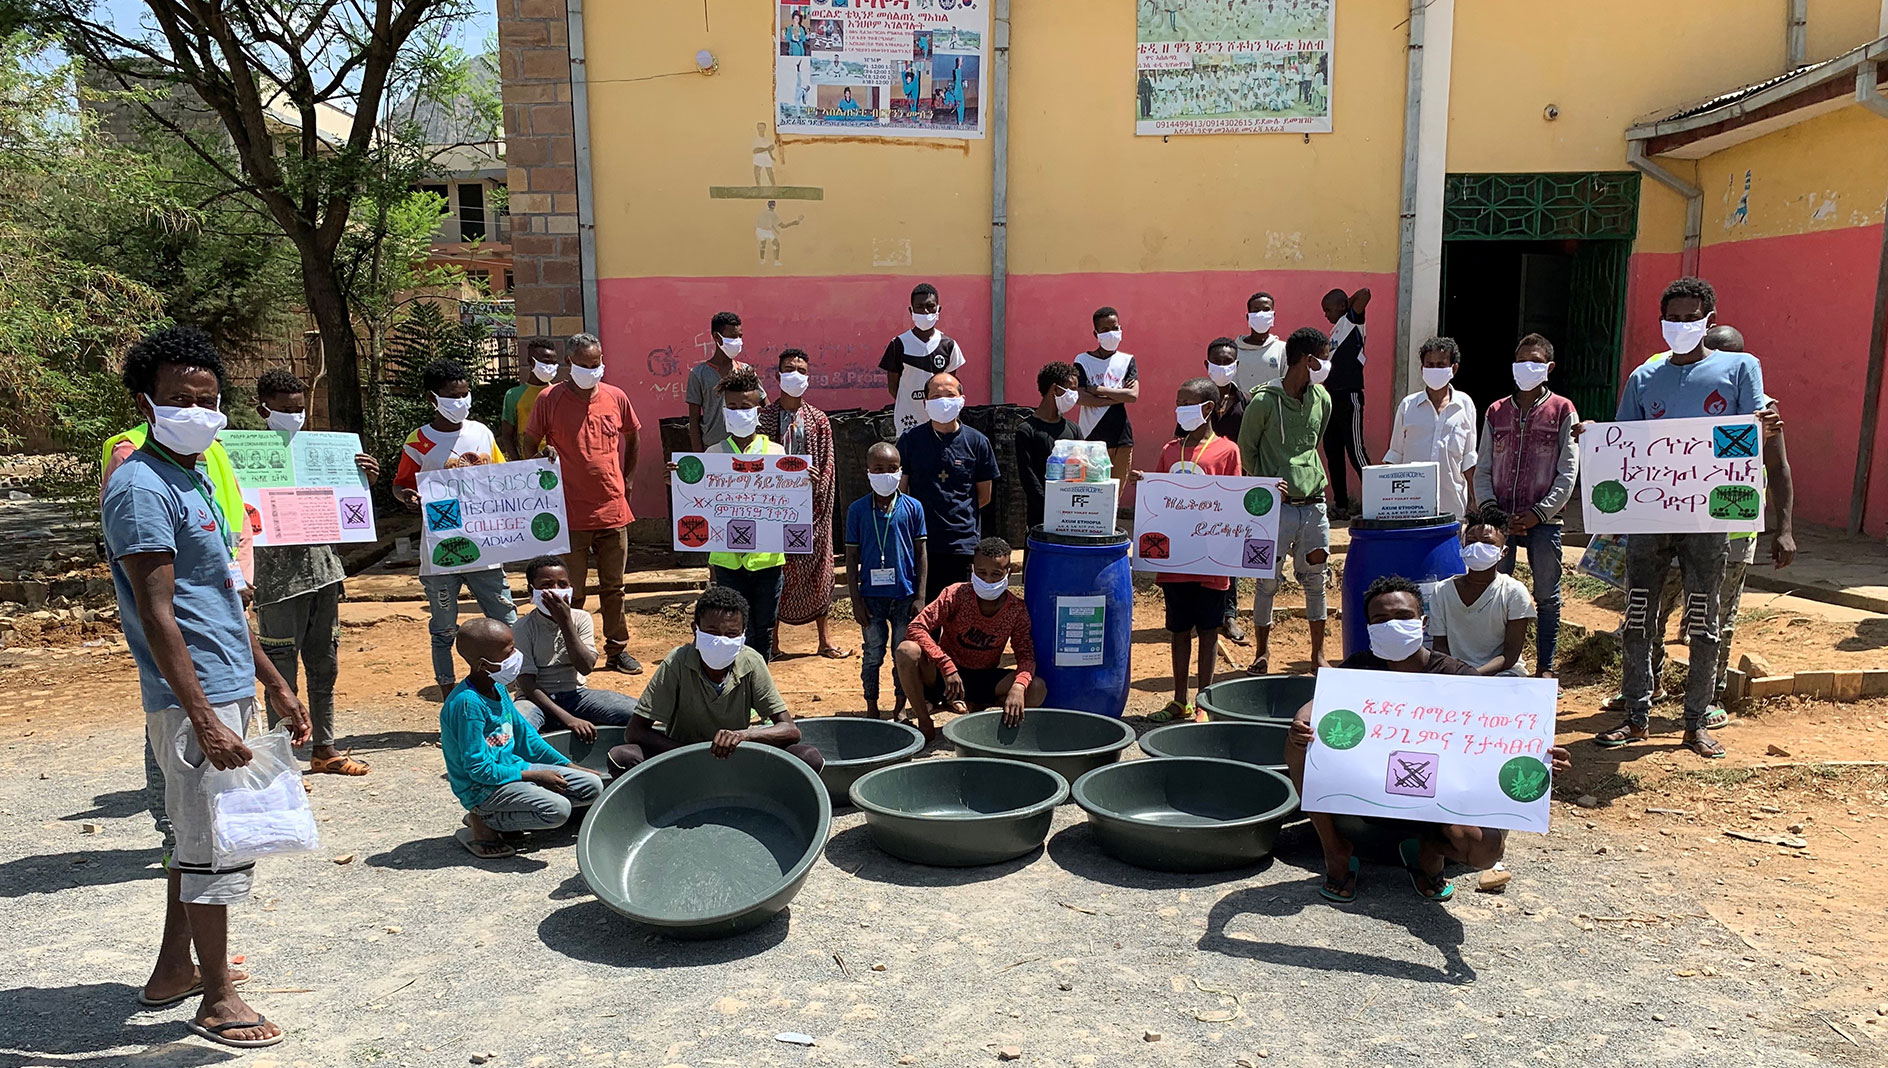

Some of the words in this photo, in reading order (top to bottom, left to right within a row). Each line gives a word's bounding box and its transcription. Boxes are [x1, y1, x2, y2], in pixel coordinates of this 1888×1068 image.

[428, 478, 476, 500] DON
[464, 517, 526, 534] COLLEGE
[481, 533, 525, 547] ADWA
